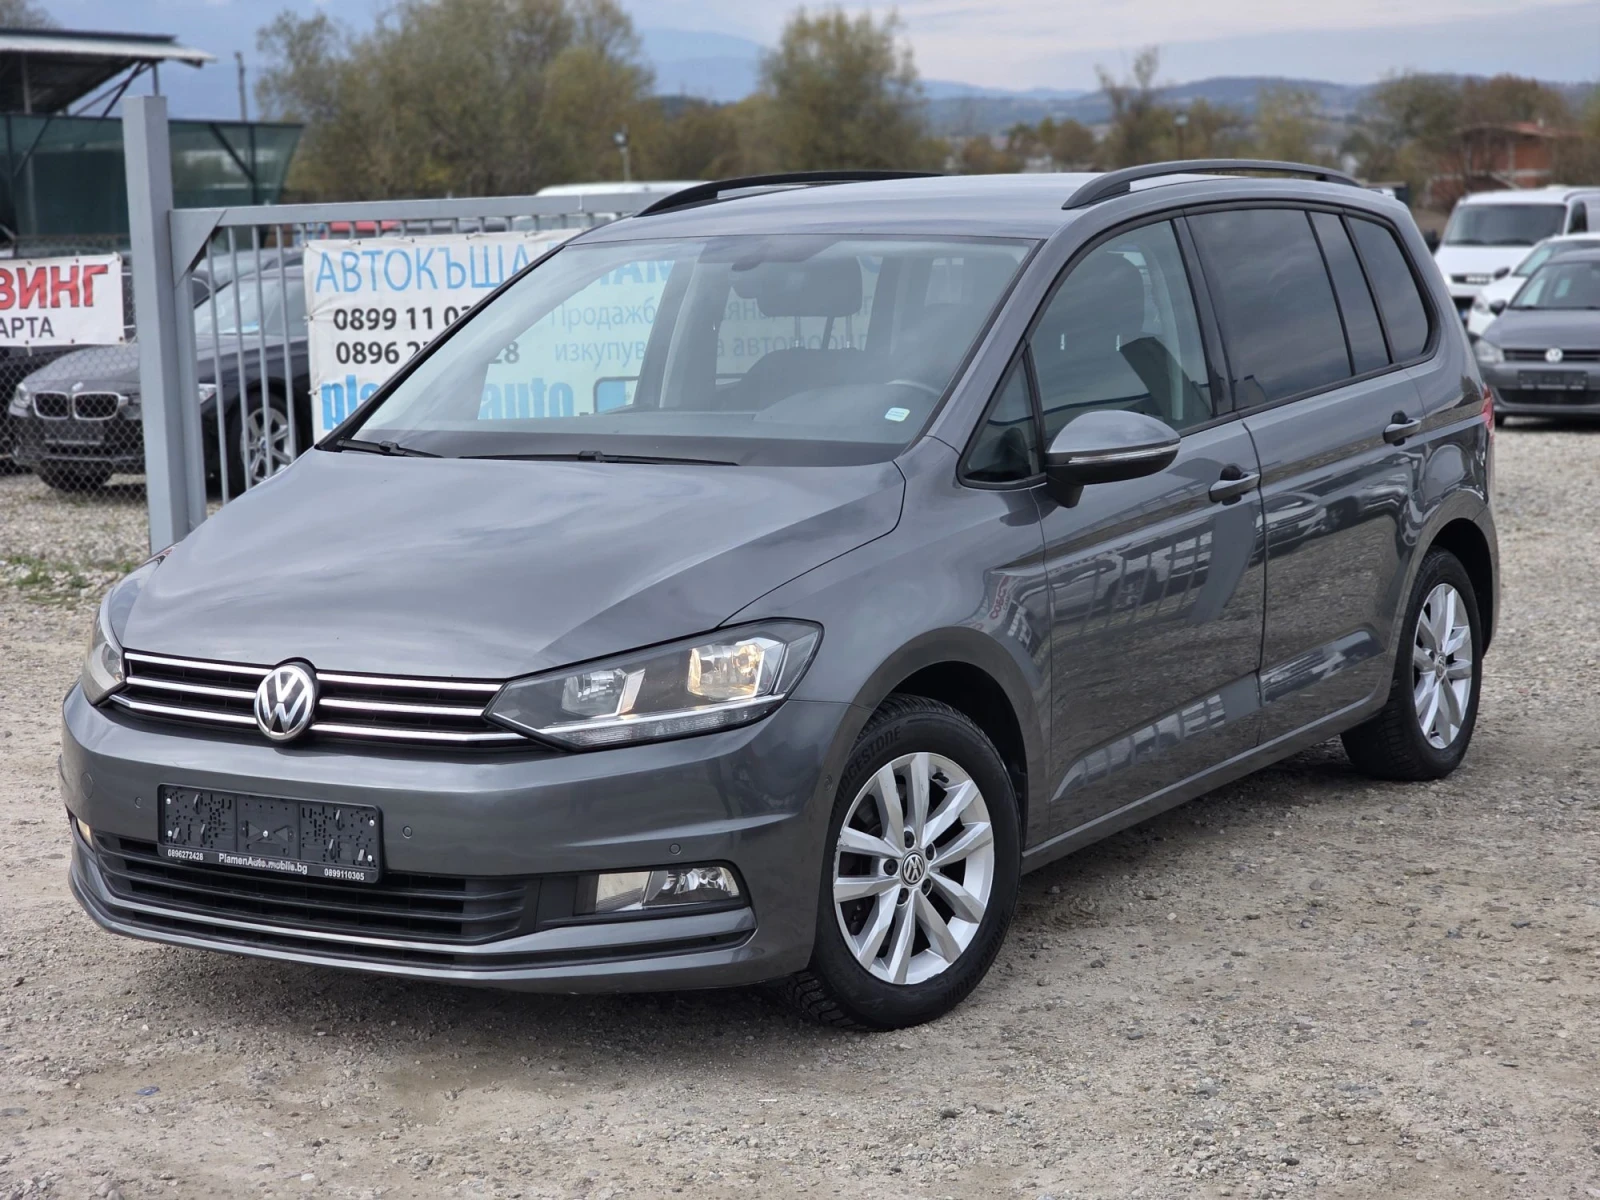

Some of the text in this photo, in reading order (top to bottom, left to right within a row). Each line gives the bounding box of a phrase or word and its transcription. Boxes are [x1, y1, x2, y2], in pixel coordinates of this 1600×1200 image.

[334, 307, 397, 331] 0899
[406, 306, 433, 330] 11
[336, 341, 400, 364] 0896
[167, 848, 365, 881] 0896272428 PlamenAuto.mobile.bg 0899110305
